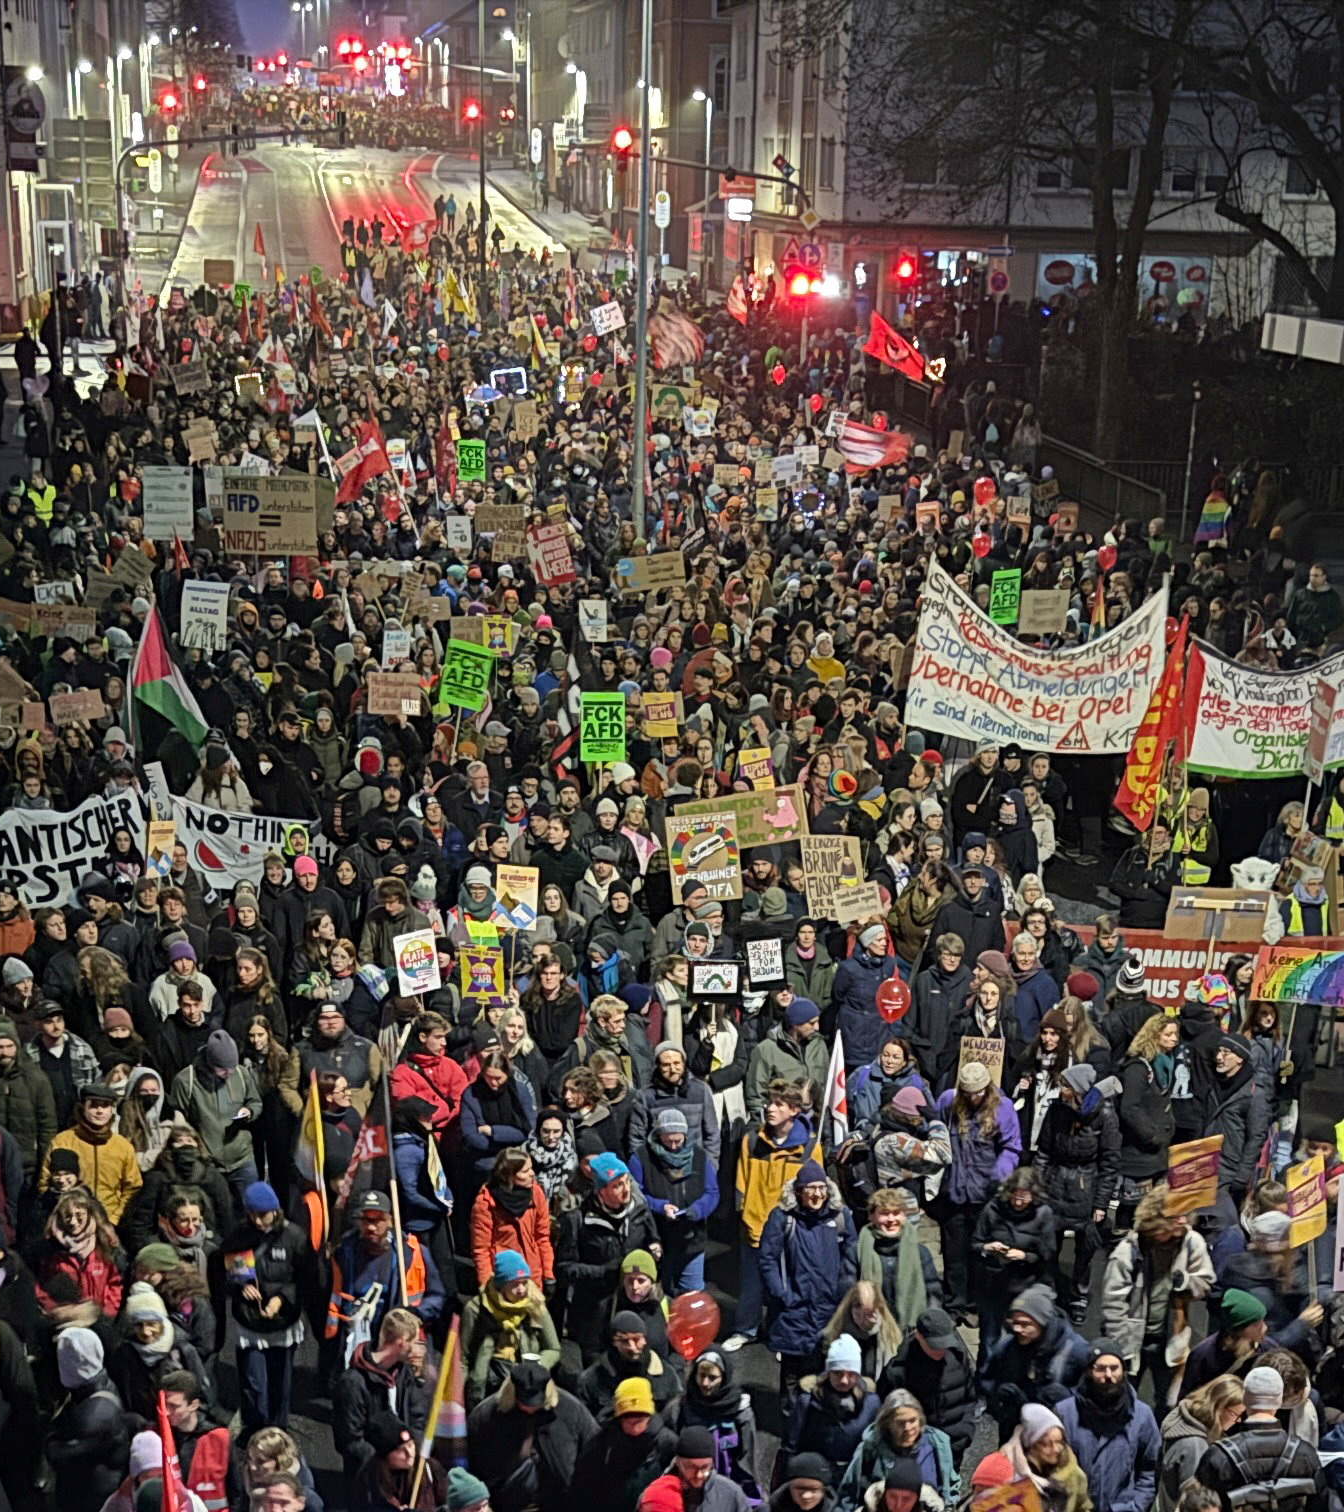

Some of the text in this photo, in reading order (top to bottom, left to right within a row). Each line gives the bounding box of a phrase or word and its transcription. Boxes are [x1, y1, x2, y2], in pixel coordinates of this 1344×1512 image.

[459, 448, 483, 459] FCK
[459, 458, 484, 469] AFD
[227, 494, 260, 512] AFD
[226, 530, 266, 551] NAZIS
[993, 581, 1016, 594] FCK
[992, 594, 1017, 606] AFD
[920, 624, 992, 675] Stoppt
[448, 652, 485, 673] FCK
[446, 668, 485, 689] AFD
[583, 706, 623, 722] FCK
[1032, 695, 1065, 724] bei
[1079, 689, 1133, 724] Opel
[582, 722, 623, 738] AFD
[933, 699, 967, 724] sind
[970, 709, 1051, 745] international
[1256, 745, 1306, 770] Dich!
[1268, 949, 1304, 967] keine
[1257, 981, 1277, 999] tut
